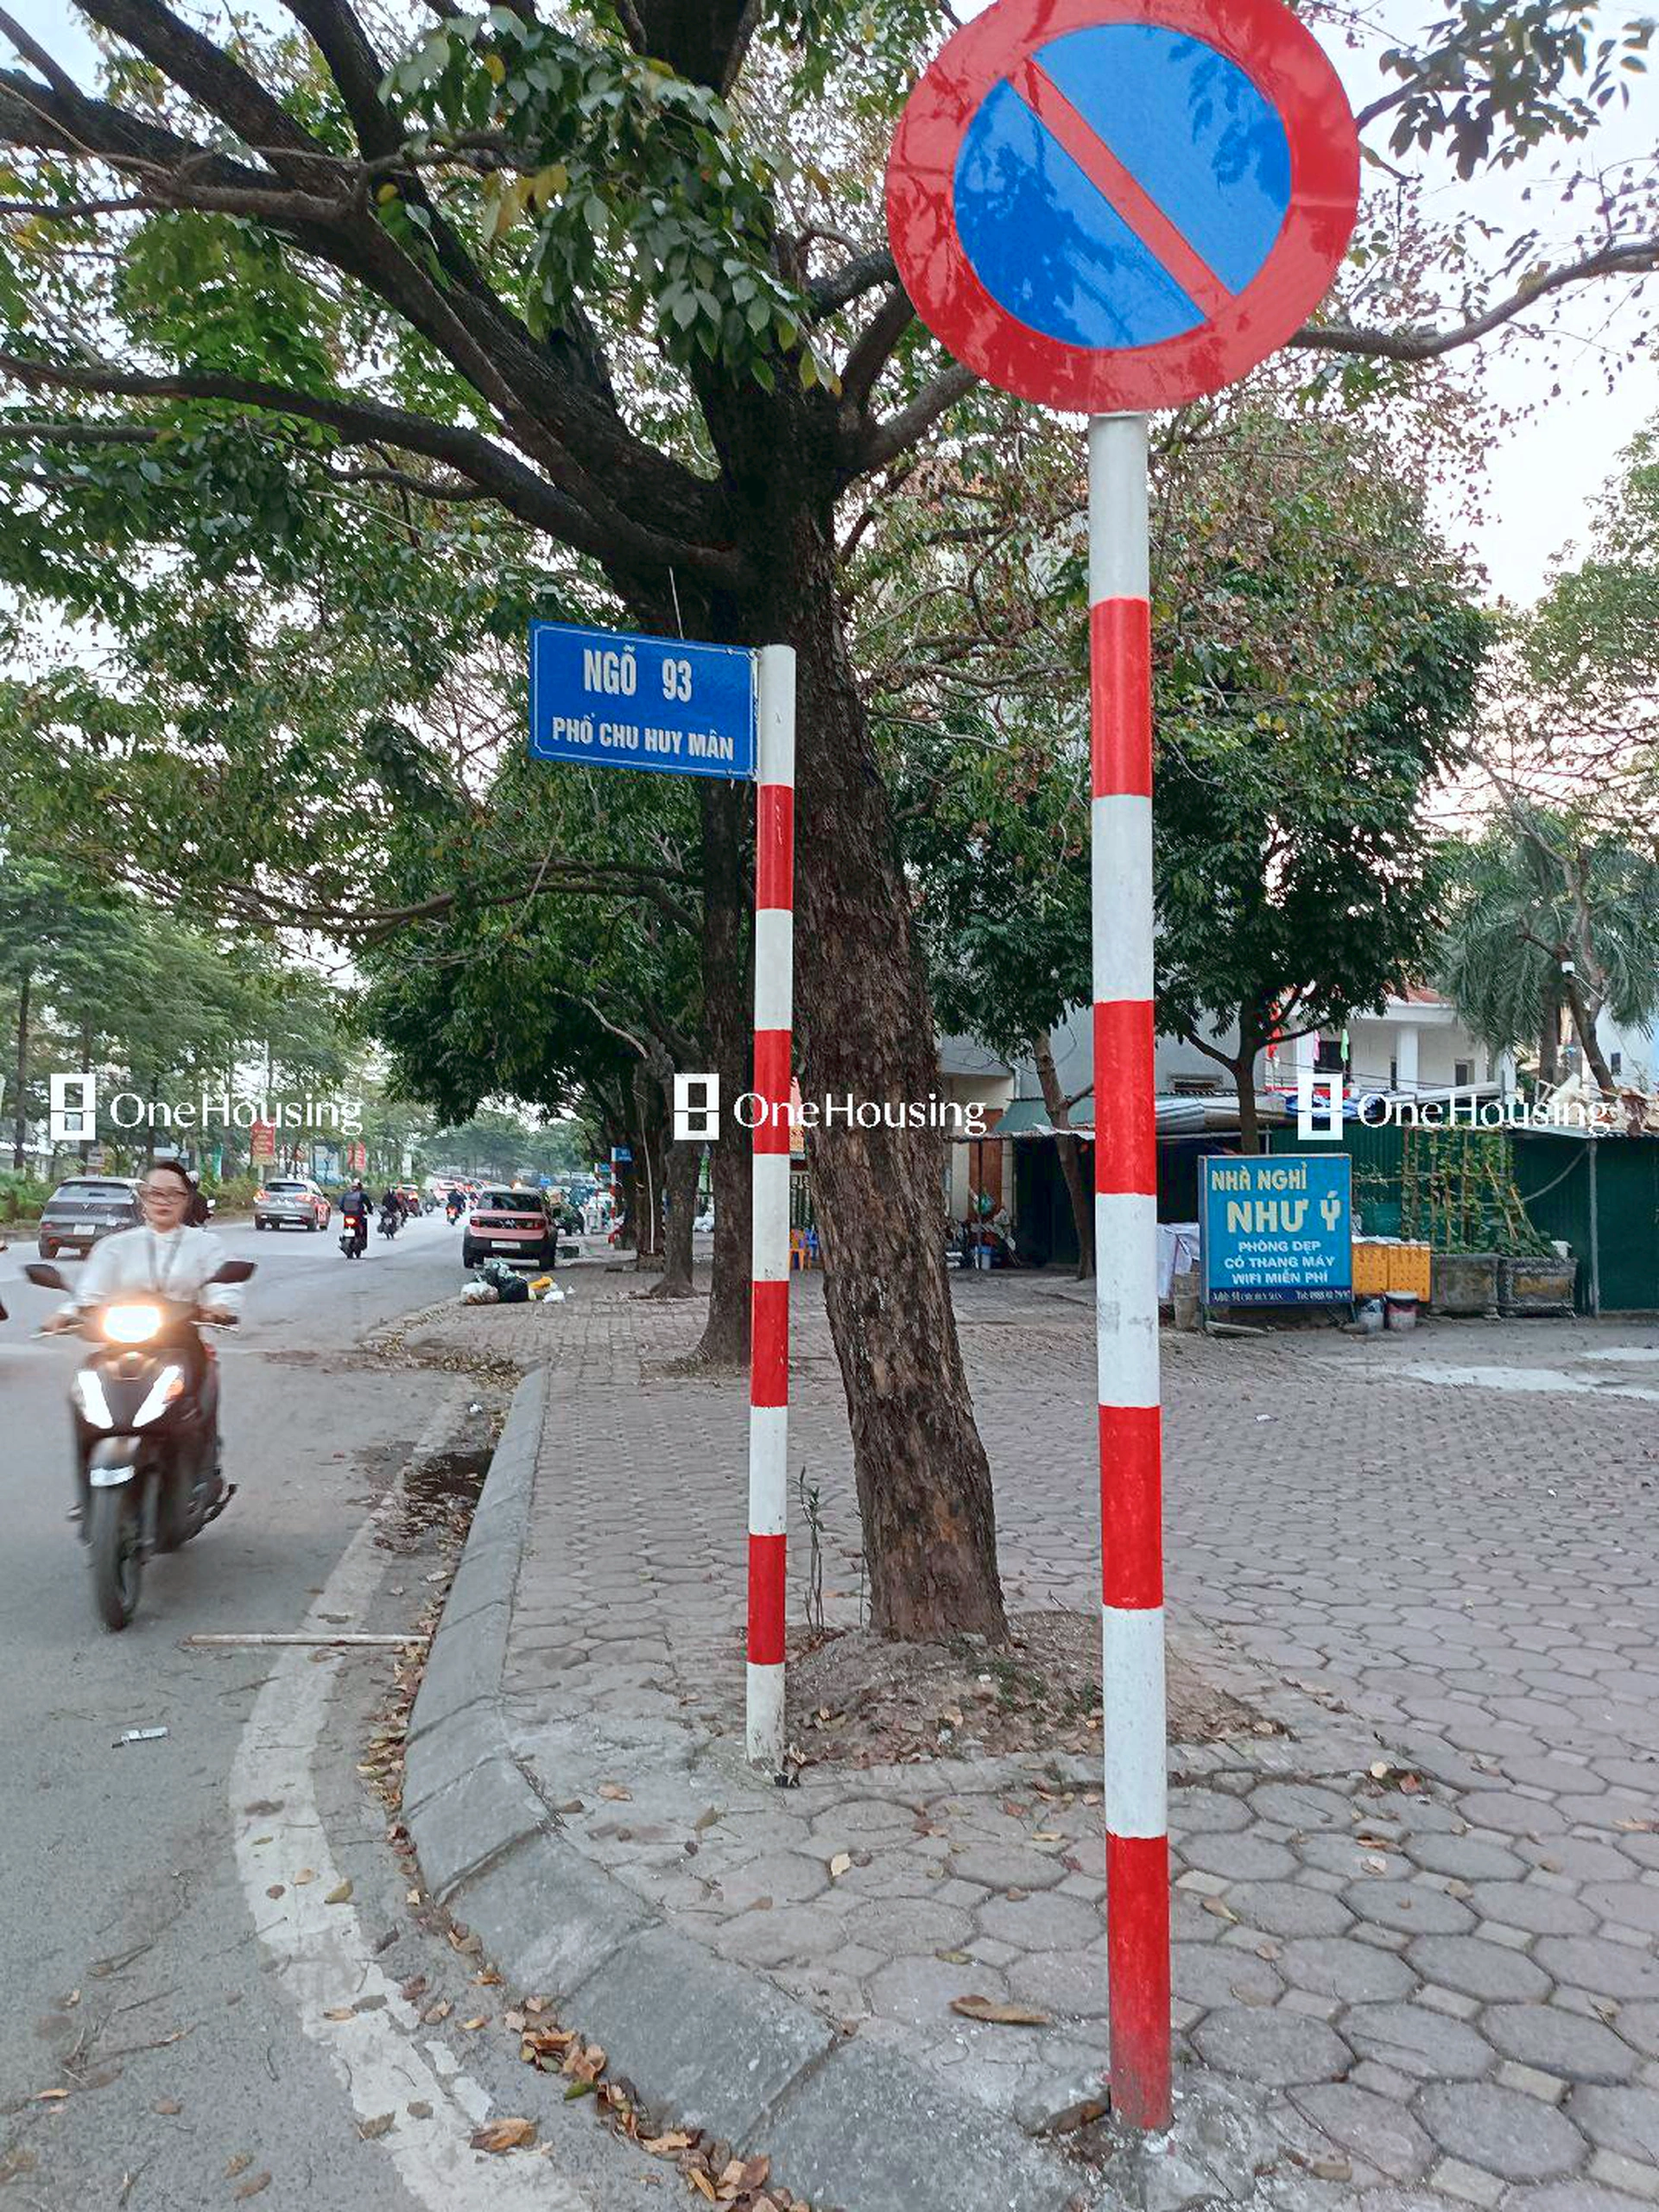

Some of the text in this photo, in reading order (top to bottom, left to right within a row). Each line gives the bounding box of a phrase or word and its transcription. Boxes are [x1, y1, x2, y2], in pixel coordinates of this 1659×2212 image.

[584, 644, 693, 703] NGÕ 93
[598, 722, 639, 751] CHU
[644, 727, 683, 754] HUY
[687, 729, 734, 761] MÂN
[1212, 1161, 1308, 1191] NHÀ NGHỈ
[1227, 1189, 1341, 1233] NHƯ Ý
[1224, 1254, 1336, 1269] CÓ THANG MÁY
[1232, 1272, 1262, 1285] WIFI
[1305, 1270, 1328, 1283] PHÍ
